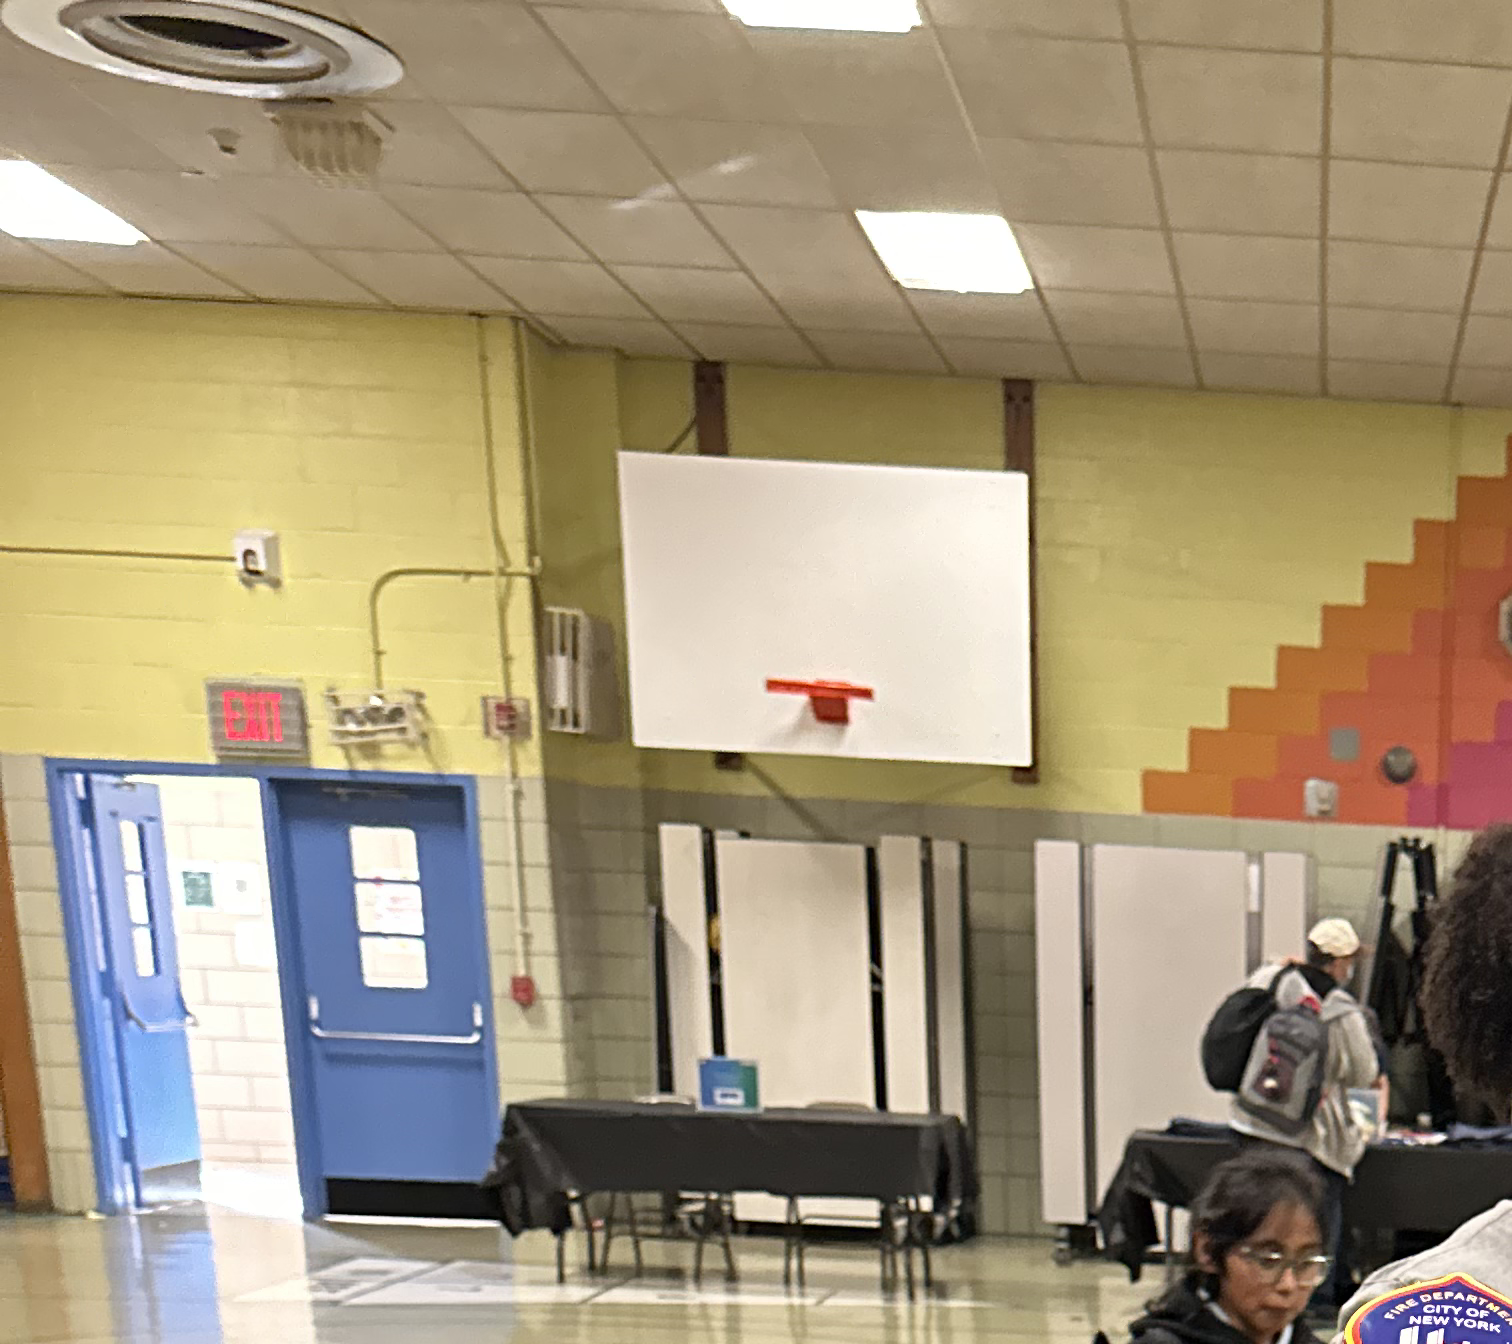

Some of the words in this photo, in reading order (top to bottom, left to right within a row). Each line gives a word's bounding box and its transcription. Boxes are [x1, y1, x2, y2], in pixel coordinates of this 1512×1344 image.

[222, 691, 284, 743] EXIT
[1383, 1298, 1419, 1321] FIRE
[1422, 1303, 1464, 1316] CITY
[1465, 1307, 1490, 1320] OF
[1408, 1315, 1450, 1326] NEW
[1453, 1316, 1501, 1334] YORK
